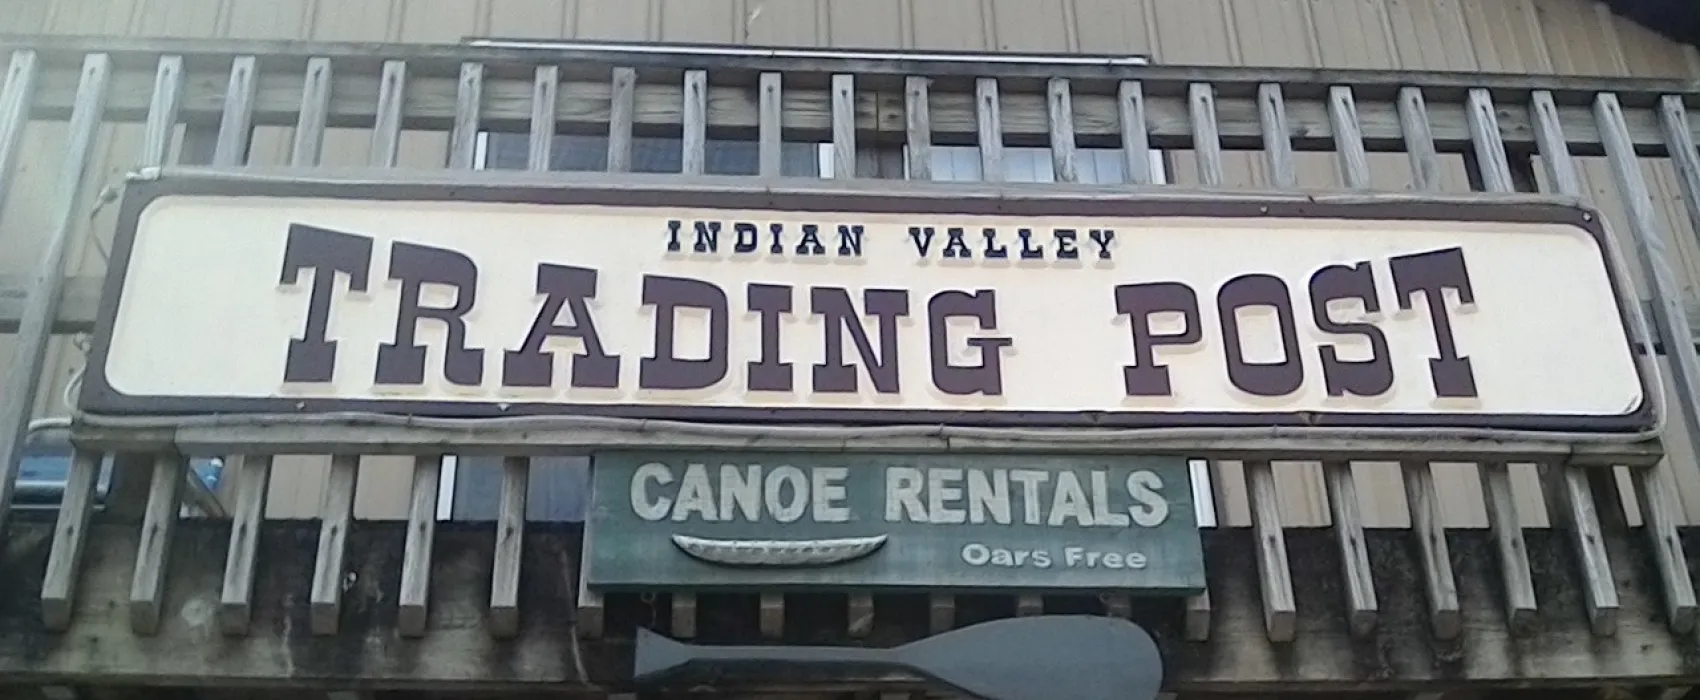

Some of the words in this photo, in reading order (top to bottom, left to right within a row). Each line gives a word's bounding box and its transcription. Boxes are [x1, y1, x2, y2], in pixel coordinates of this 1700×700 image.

[666, 220, 865, 257] INDIAN
[908, 227, 1116, 259] VALLEY
[278, 223, 1013, 397] TRADING
[1114, 247, 1477, 399] POST
[630, 462, 852, 523] CANOE
[885, 466, 1169, 528] RENTALS
[961, 543, 1052, 568] Oars
[1066, 546, 1147, 570] Free
